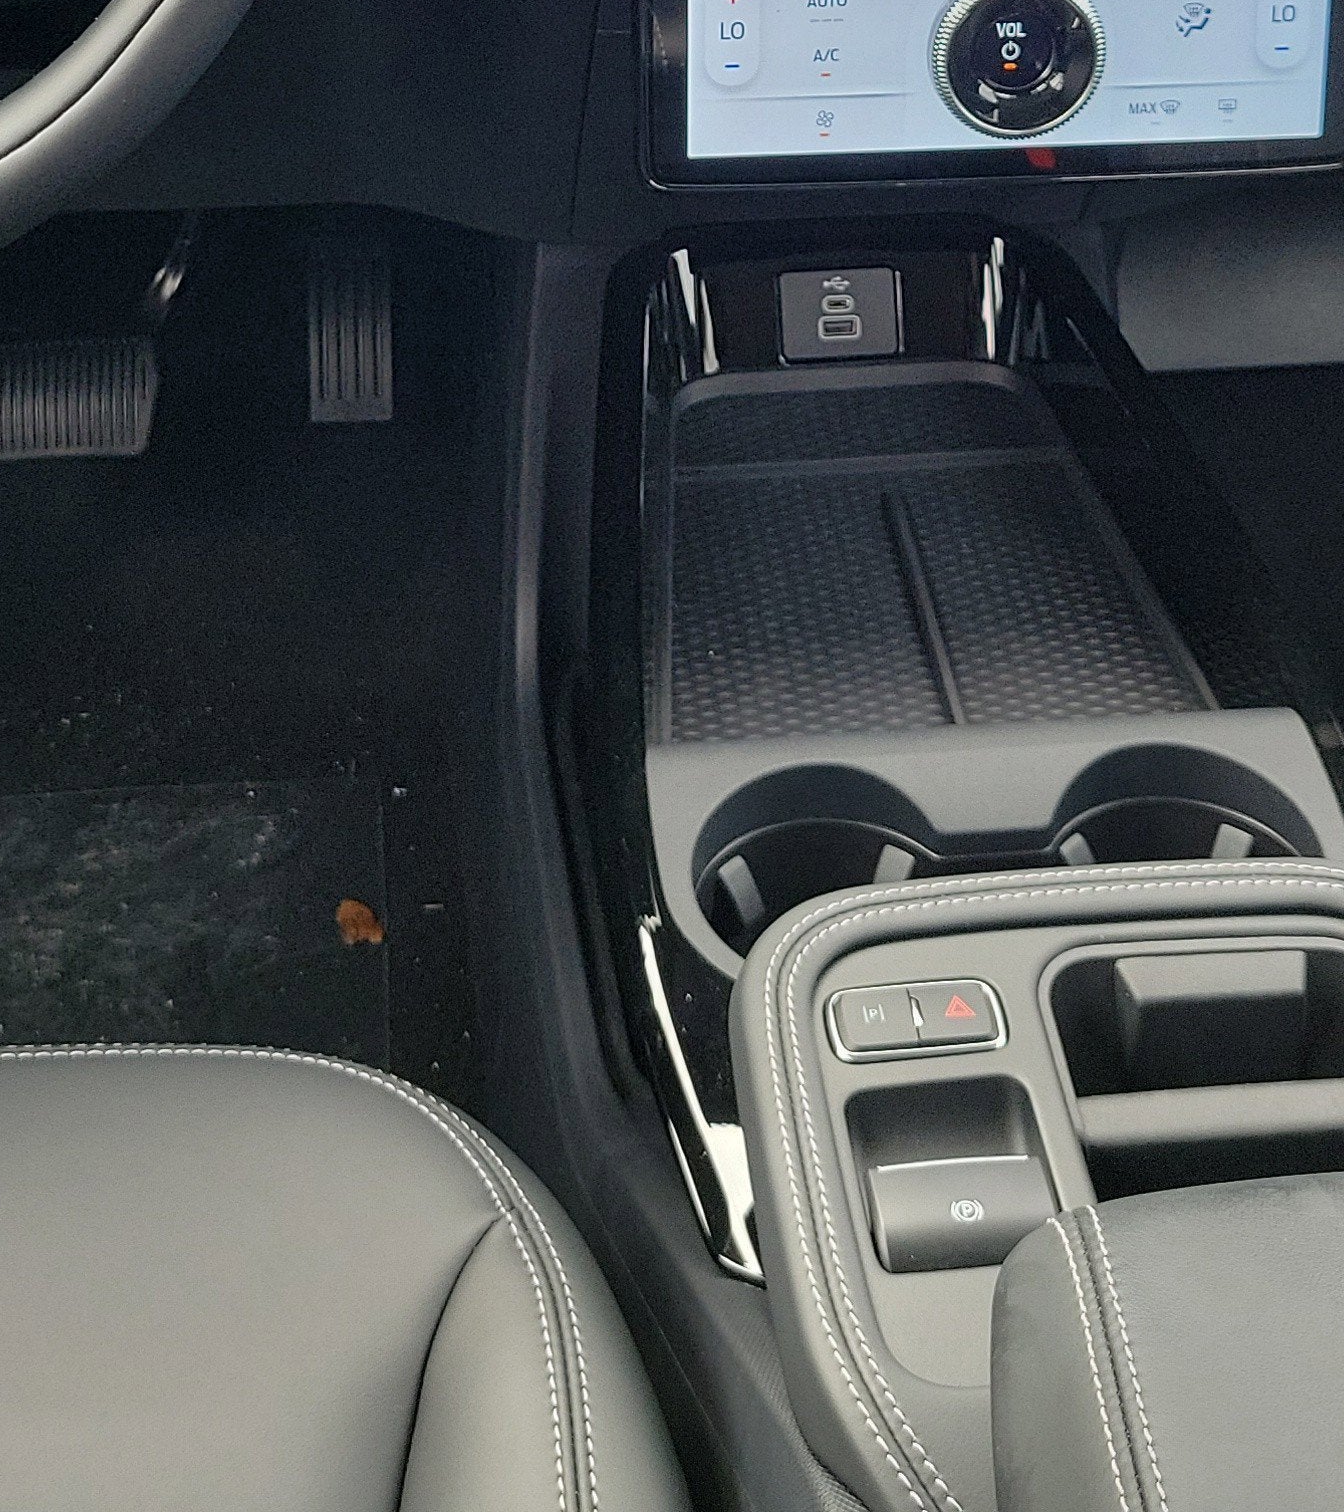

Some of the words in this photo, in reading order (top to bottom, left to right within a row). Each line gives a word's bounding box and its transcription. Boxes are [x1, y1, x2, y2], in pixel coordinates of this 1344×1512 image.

[1271, 4, 1297, 23] LO
[719, 21, 746, 41] LO
[995, 21, 1027, 39] VOL
[813, 48, 841, 63] A/C
[1128, 101, 1157, 115] MAX
